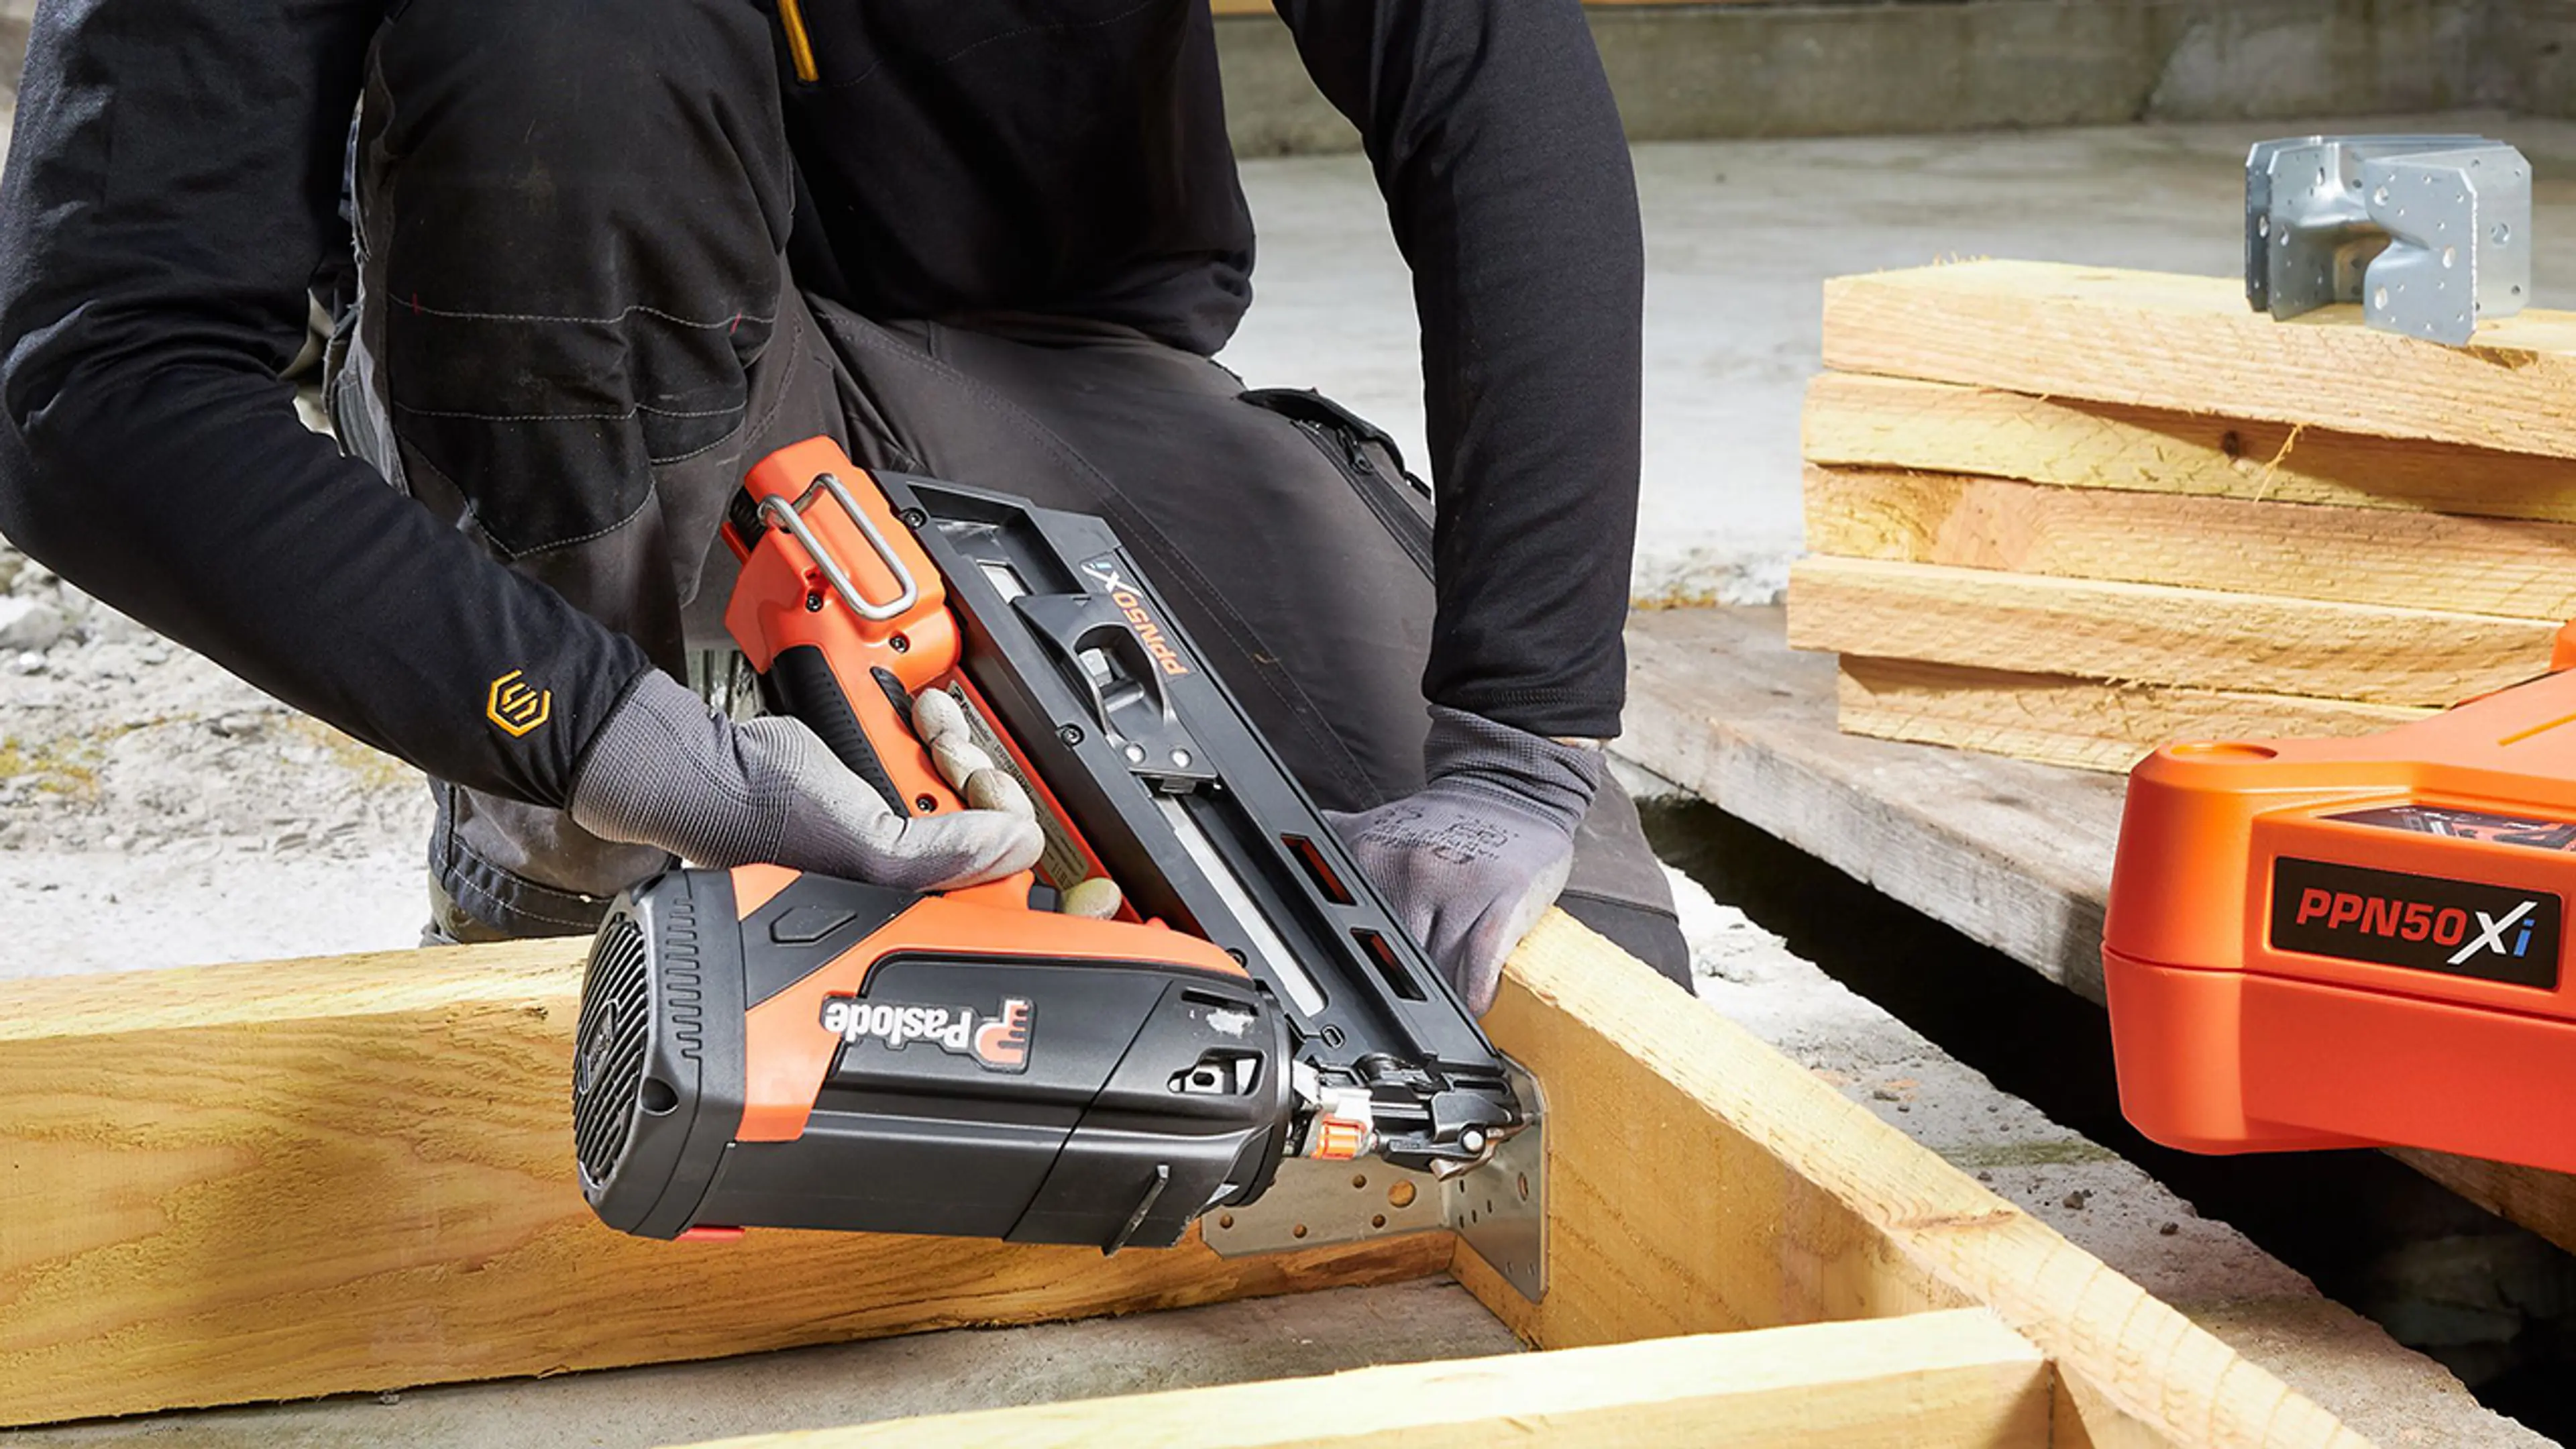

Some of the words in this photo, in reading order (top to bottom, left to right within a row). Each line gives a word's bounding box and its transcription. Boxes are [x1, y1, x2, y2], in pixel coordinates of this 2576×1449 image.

[1080, 562, 1189, 676] PPN50Xi
[2296, 888, 2538, 966] PPN50Xi
[824, 1002, 971, 1049] Paslode
